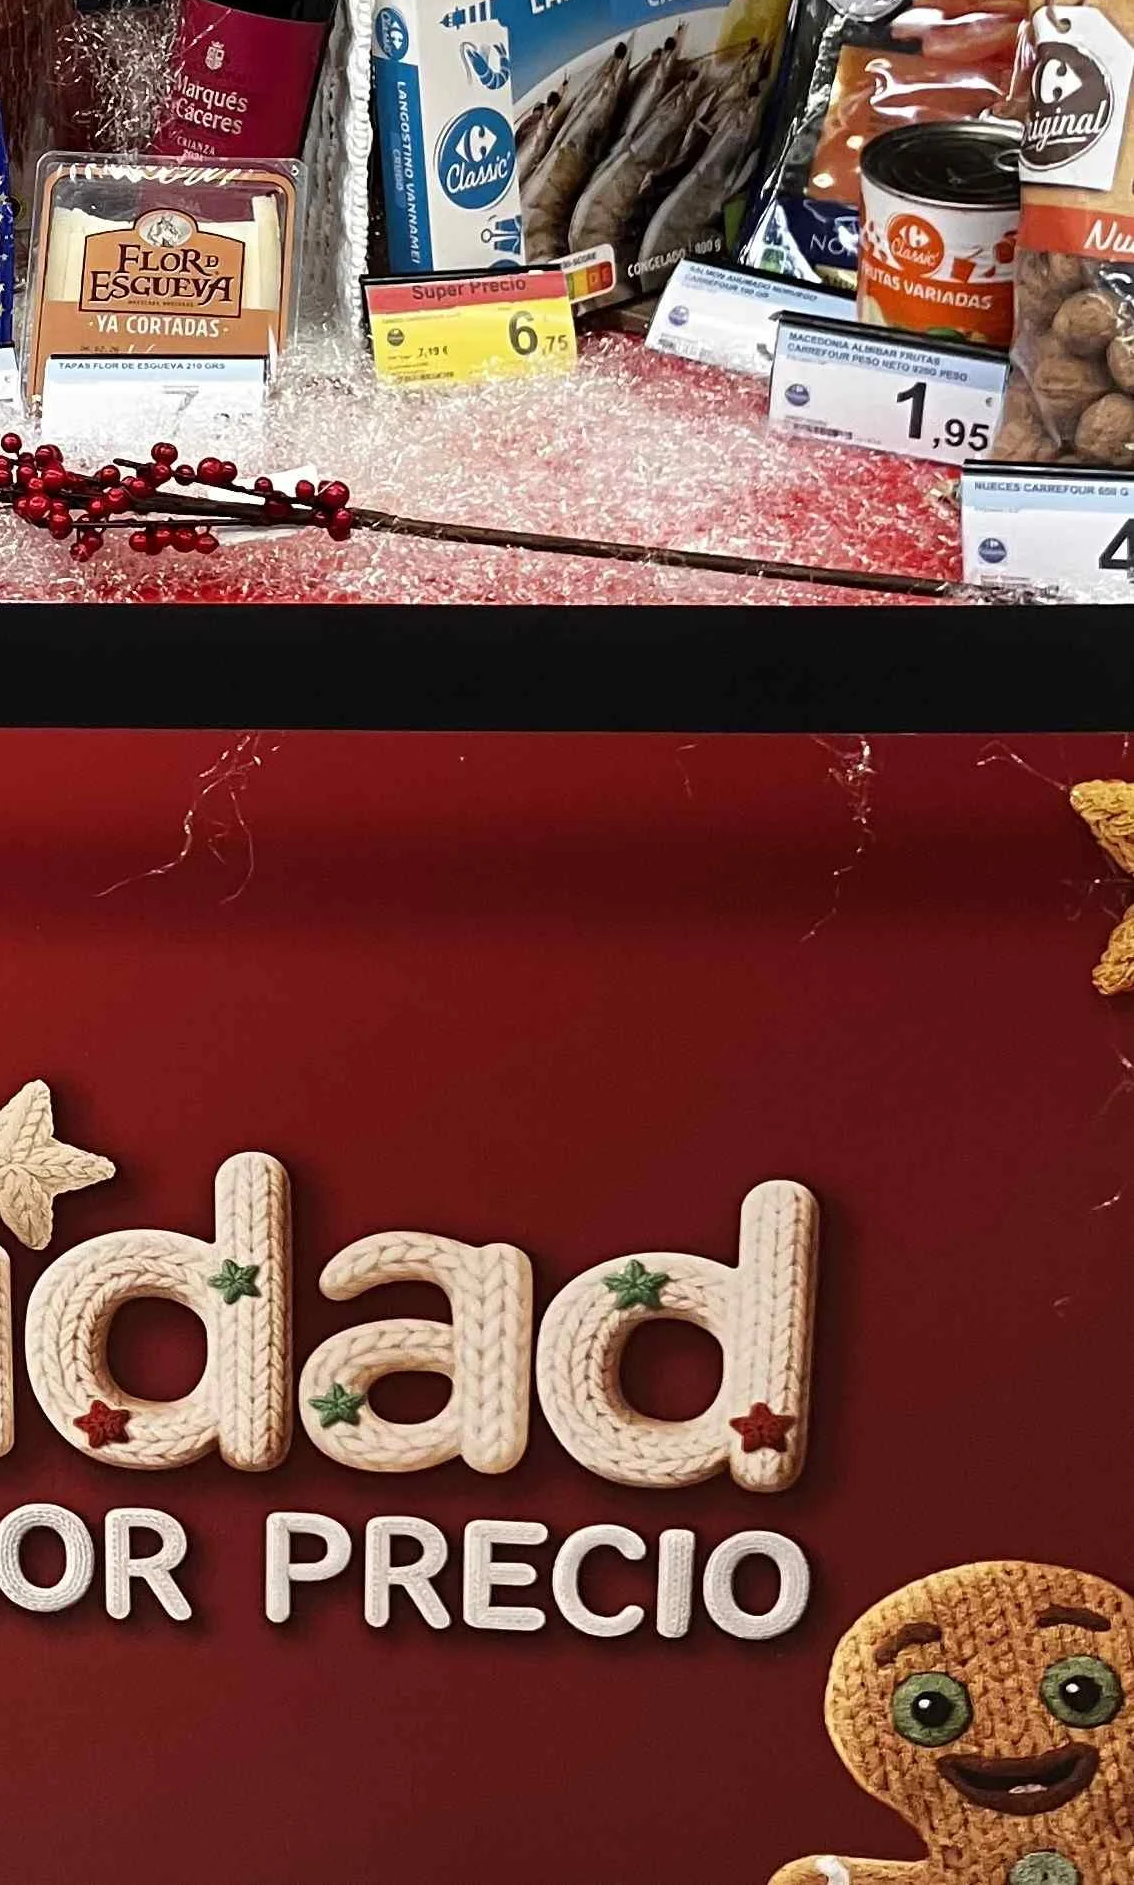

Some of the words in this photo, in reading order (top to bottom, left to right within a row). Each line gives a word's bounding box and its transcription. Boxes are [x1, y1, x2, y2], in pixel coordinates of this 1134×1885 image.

[175, 97, 243, 135] Cáceres
[177, 136, 216, 156] CRIANZA
[396, 81, 414, 179] LANGOSTINO
[406, 182, 421, 265] VANNAMEI
[446, 152, 512, 194] Classic
[118, 243, 210, 276] FLOR
[627, 247, 686, 278] CONGELADO
[89, 270, 236, 306] ESGUEVA
[412, 279, 464, 301] Super
[469, 276, 527, 295] Precio
[903, 279, 994, 311] VARIADAS
[95, 314, 119, 334] YA
[125, 316, 221, 339] CORTADAS
[508, 309, 568, 356] 6,75
[59, 362, 91, 370] TAPAS
[92, 362, 119, 370] FLOR
[121, 362, 135, 370] DE
[137, 362, 184, 370] ESGUEVA
[787, 343, 851, 362] CARREFOUR
[852, 355, 881, 368] PESO
[882, 360, 910, 373] NETO
[939, 370, 968, 382] PESO
[788, 332, 849, 350] MACEDONIA
[899, 351, 941, 366] FRUTAS
[896, 381, 990, 452] 1,95
[974, 481, 1021, 492] NUECES
[1023, 483, 1095, 496] CARREFOUR
[263, 1508, 813, 1641] PRECIO
